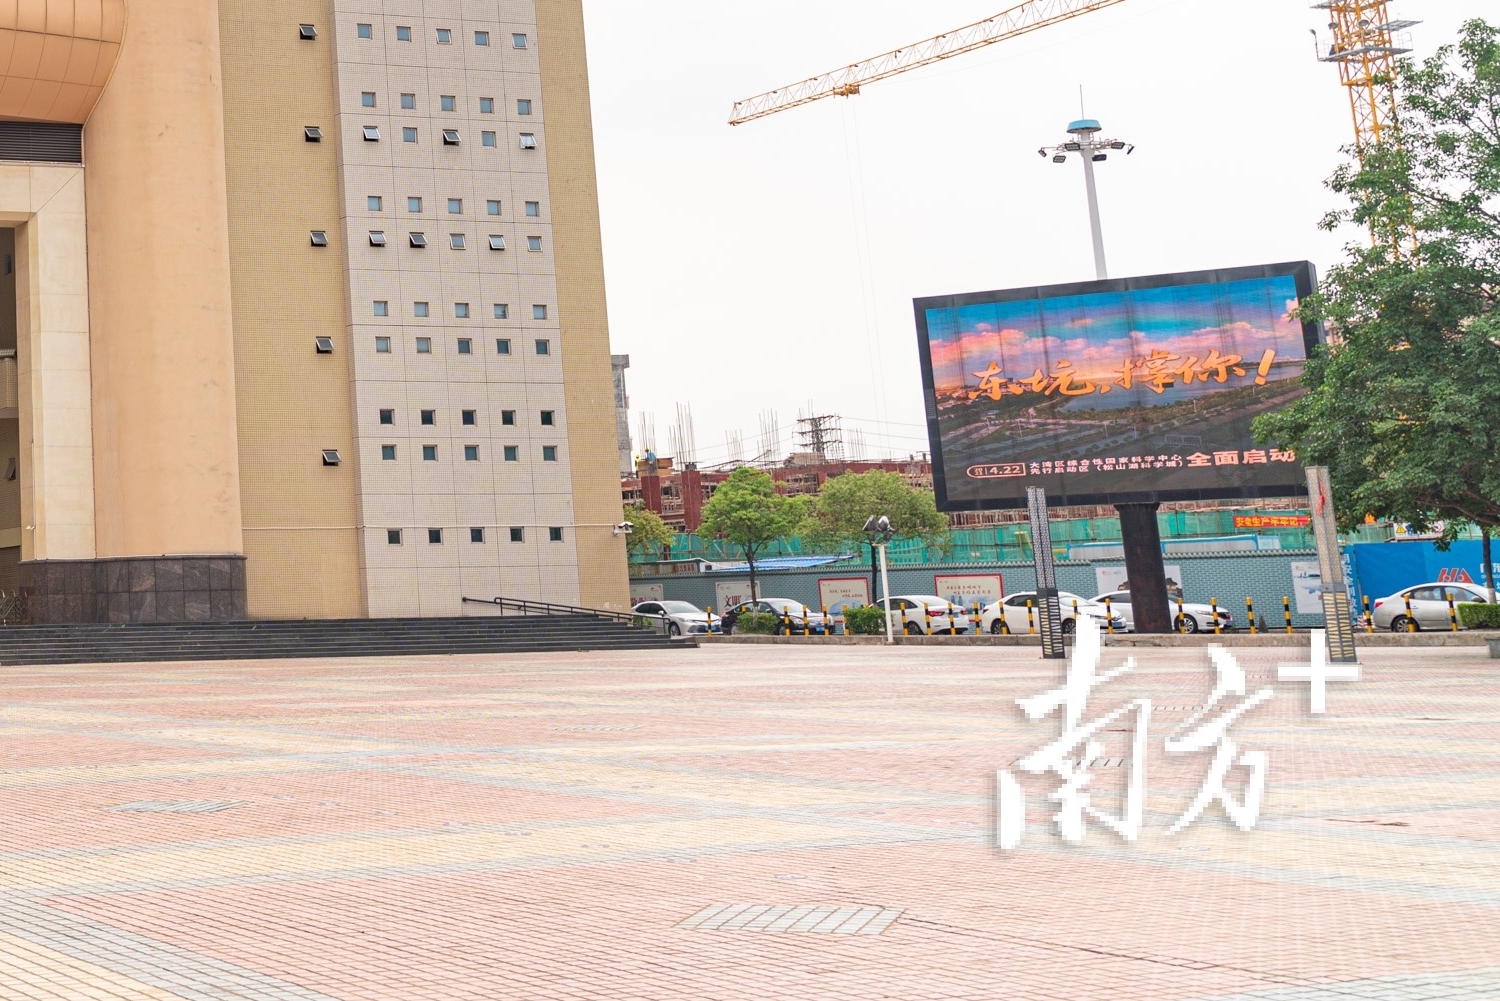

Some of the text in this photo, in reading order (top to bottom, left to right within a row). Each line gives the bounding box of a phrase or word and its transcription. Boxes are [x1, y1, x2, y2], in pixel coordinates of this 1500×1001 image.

[1029, 454, 1182, 469] 大湾区综合性国家科学中心
[1186, 448, 1296, 467] 全面启动
[990, 465, 1021, 475] 4.22
